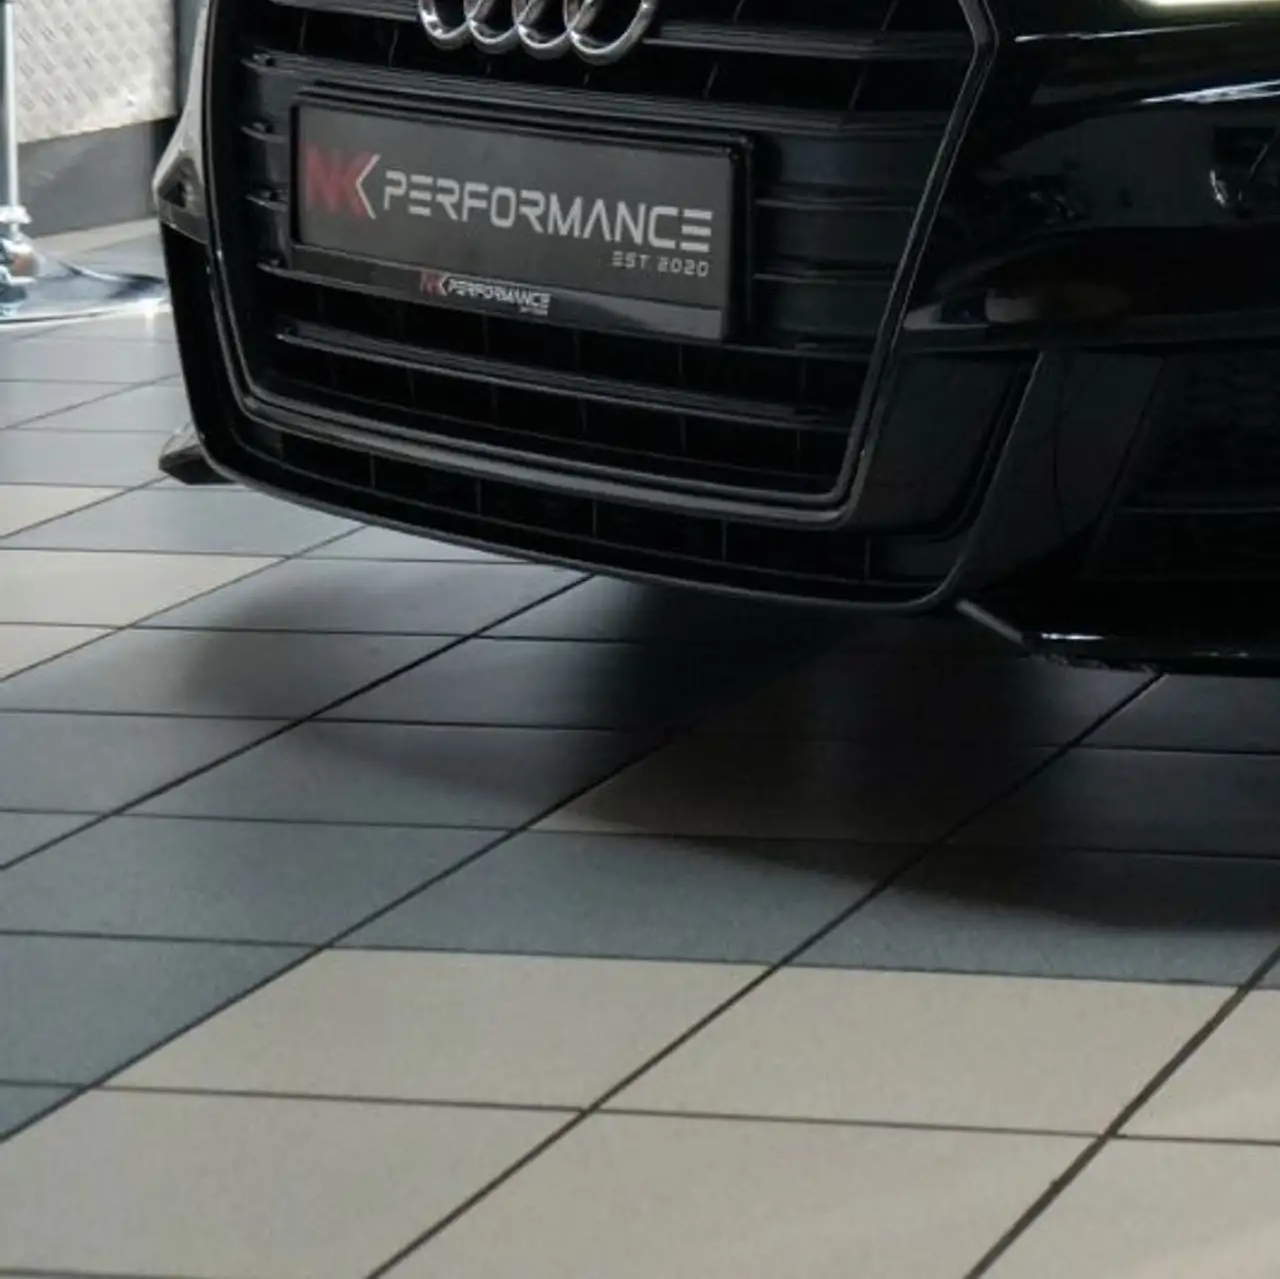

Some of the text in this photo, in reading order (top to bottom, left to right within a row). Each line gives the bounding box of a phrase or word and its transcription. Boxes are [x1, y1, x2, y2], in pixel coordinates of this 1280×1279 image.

[305, 143, 713, 254] NK PERFORMANCE
[657, 256, 709, 277] 2020
[448, 278, 551, 308] PERFORMANCE
